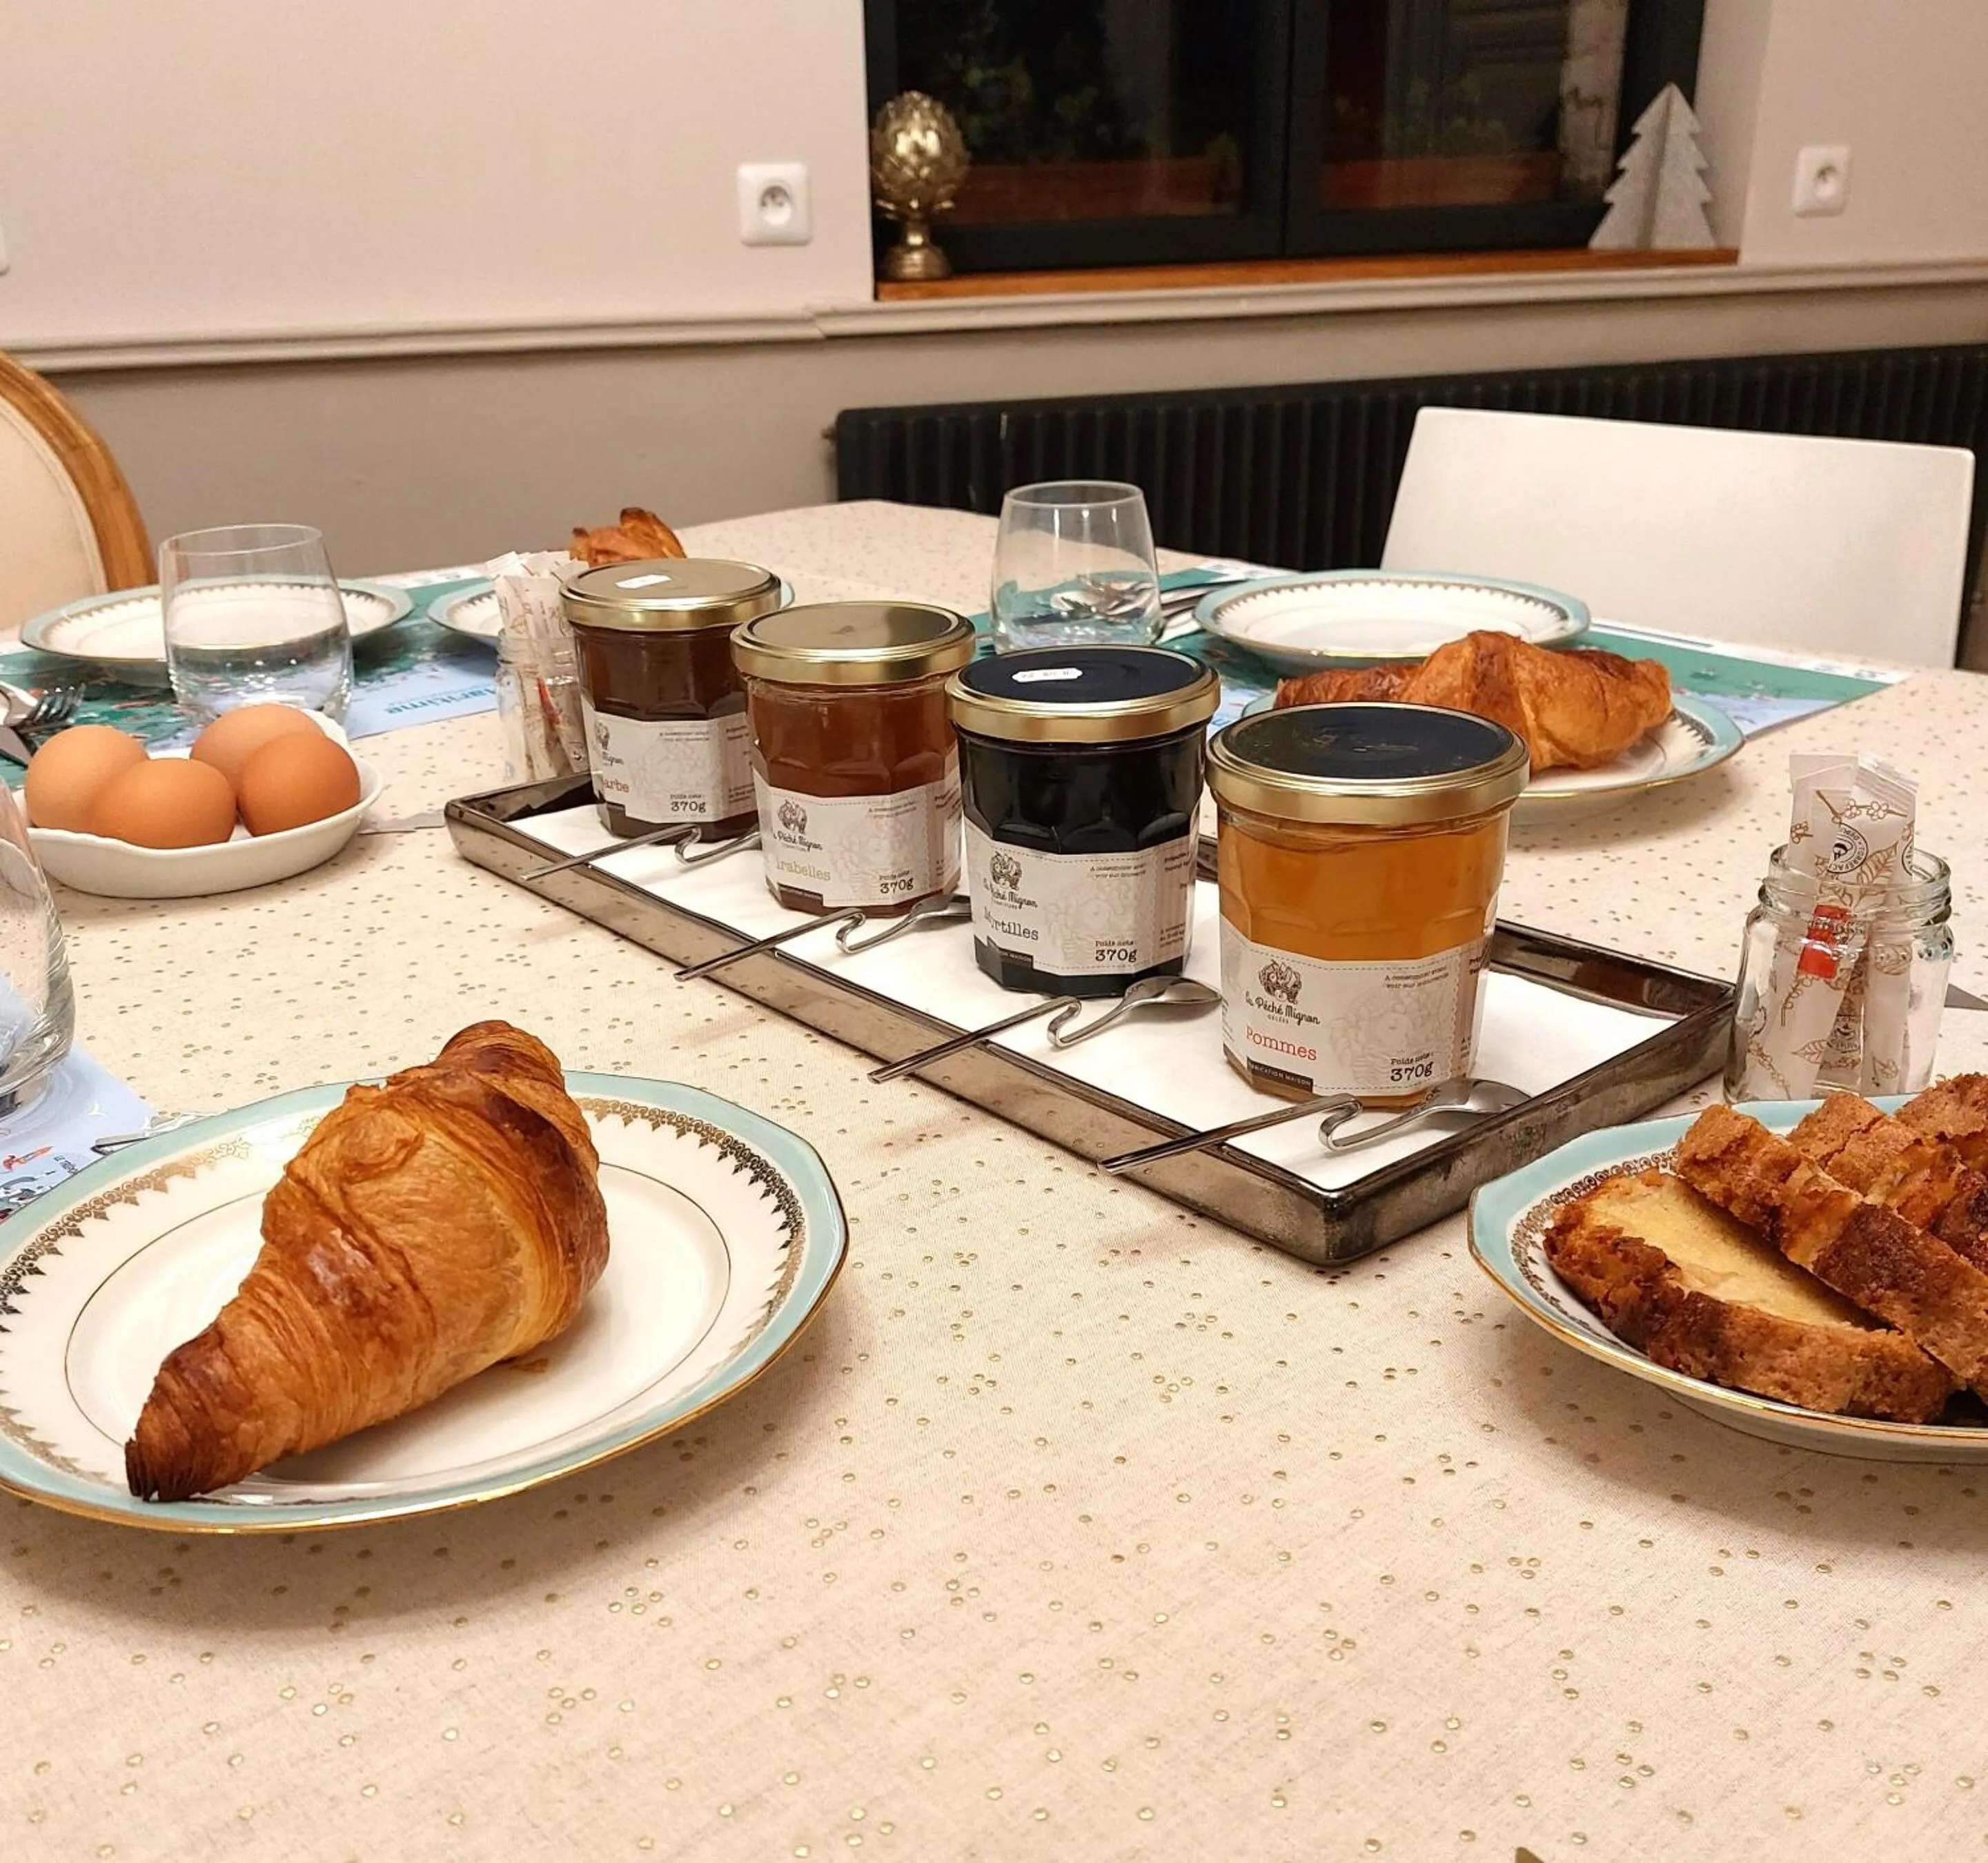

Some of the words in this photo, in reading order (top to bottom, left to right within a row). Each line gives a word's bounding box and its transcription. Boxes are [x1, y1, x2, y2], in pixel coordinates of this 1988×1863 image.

[670, 800, 707, 814] 370g
[879, 877, 914, 894] 370g
[1095, 948, 1138, 963] 370g
[1254, 996, 1284, 1016] Péché
[1285, 1004, 1321, 1026] Mignon
[1246, 1025, 1317, 1061] Pommes
[1390, 1061, 1434, 1082] 370g
